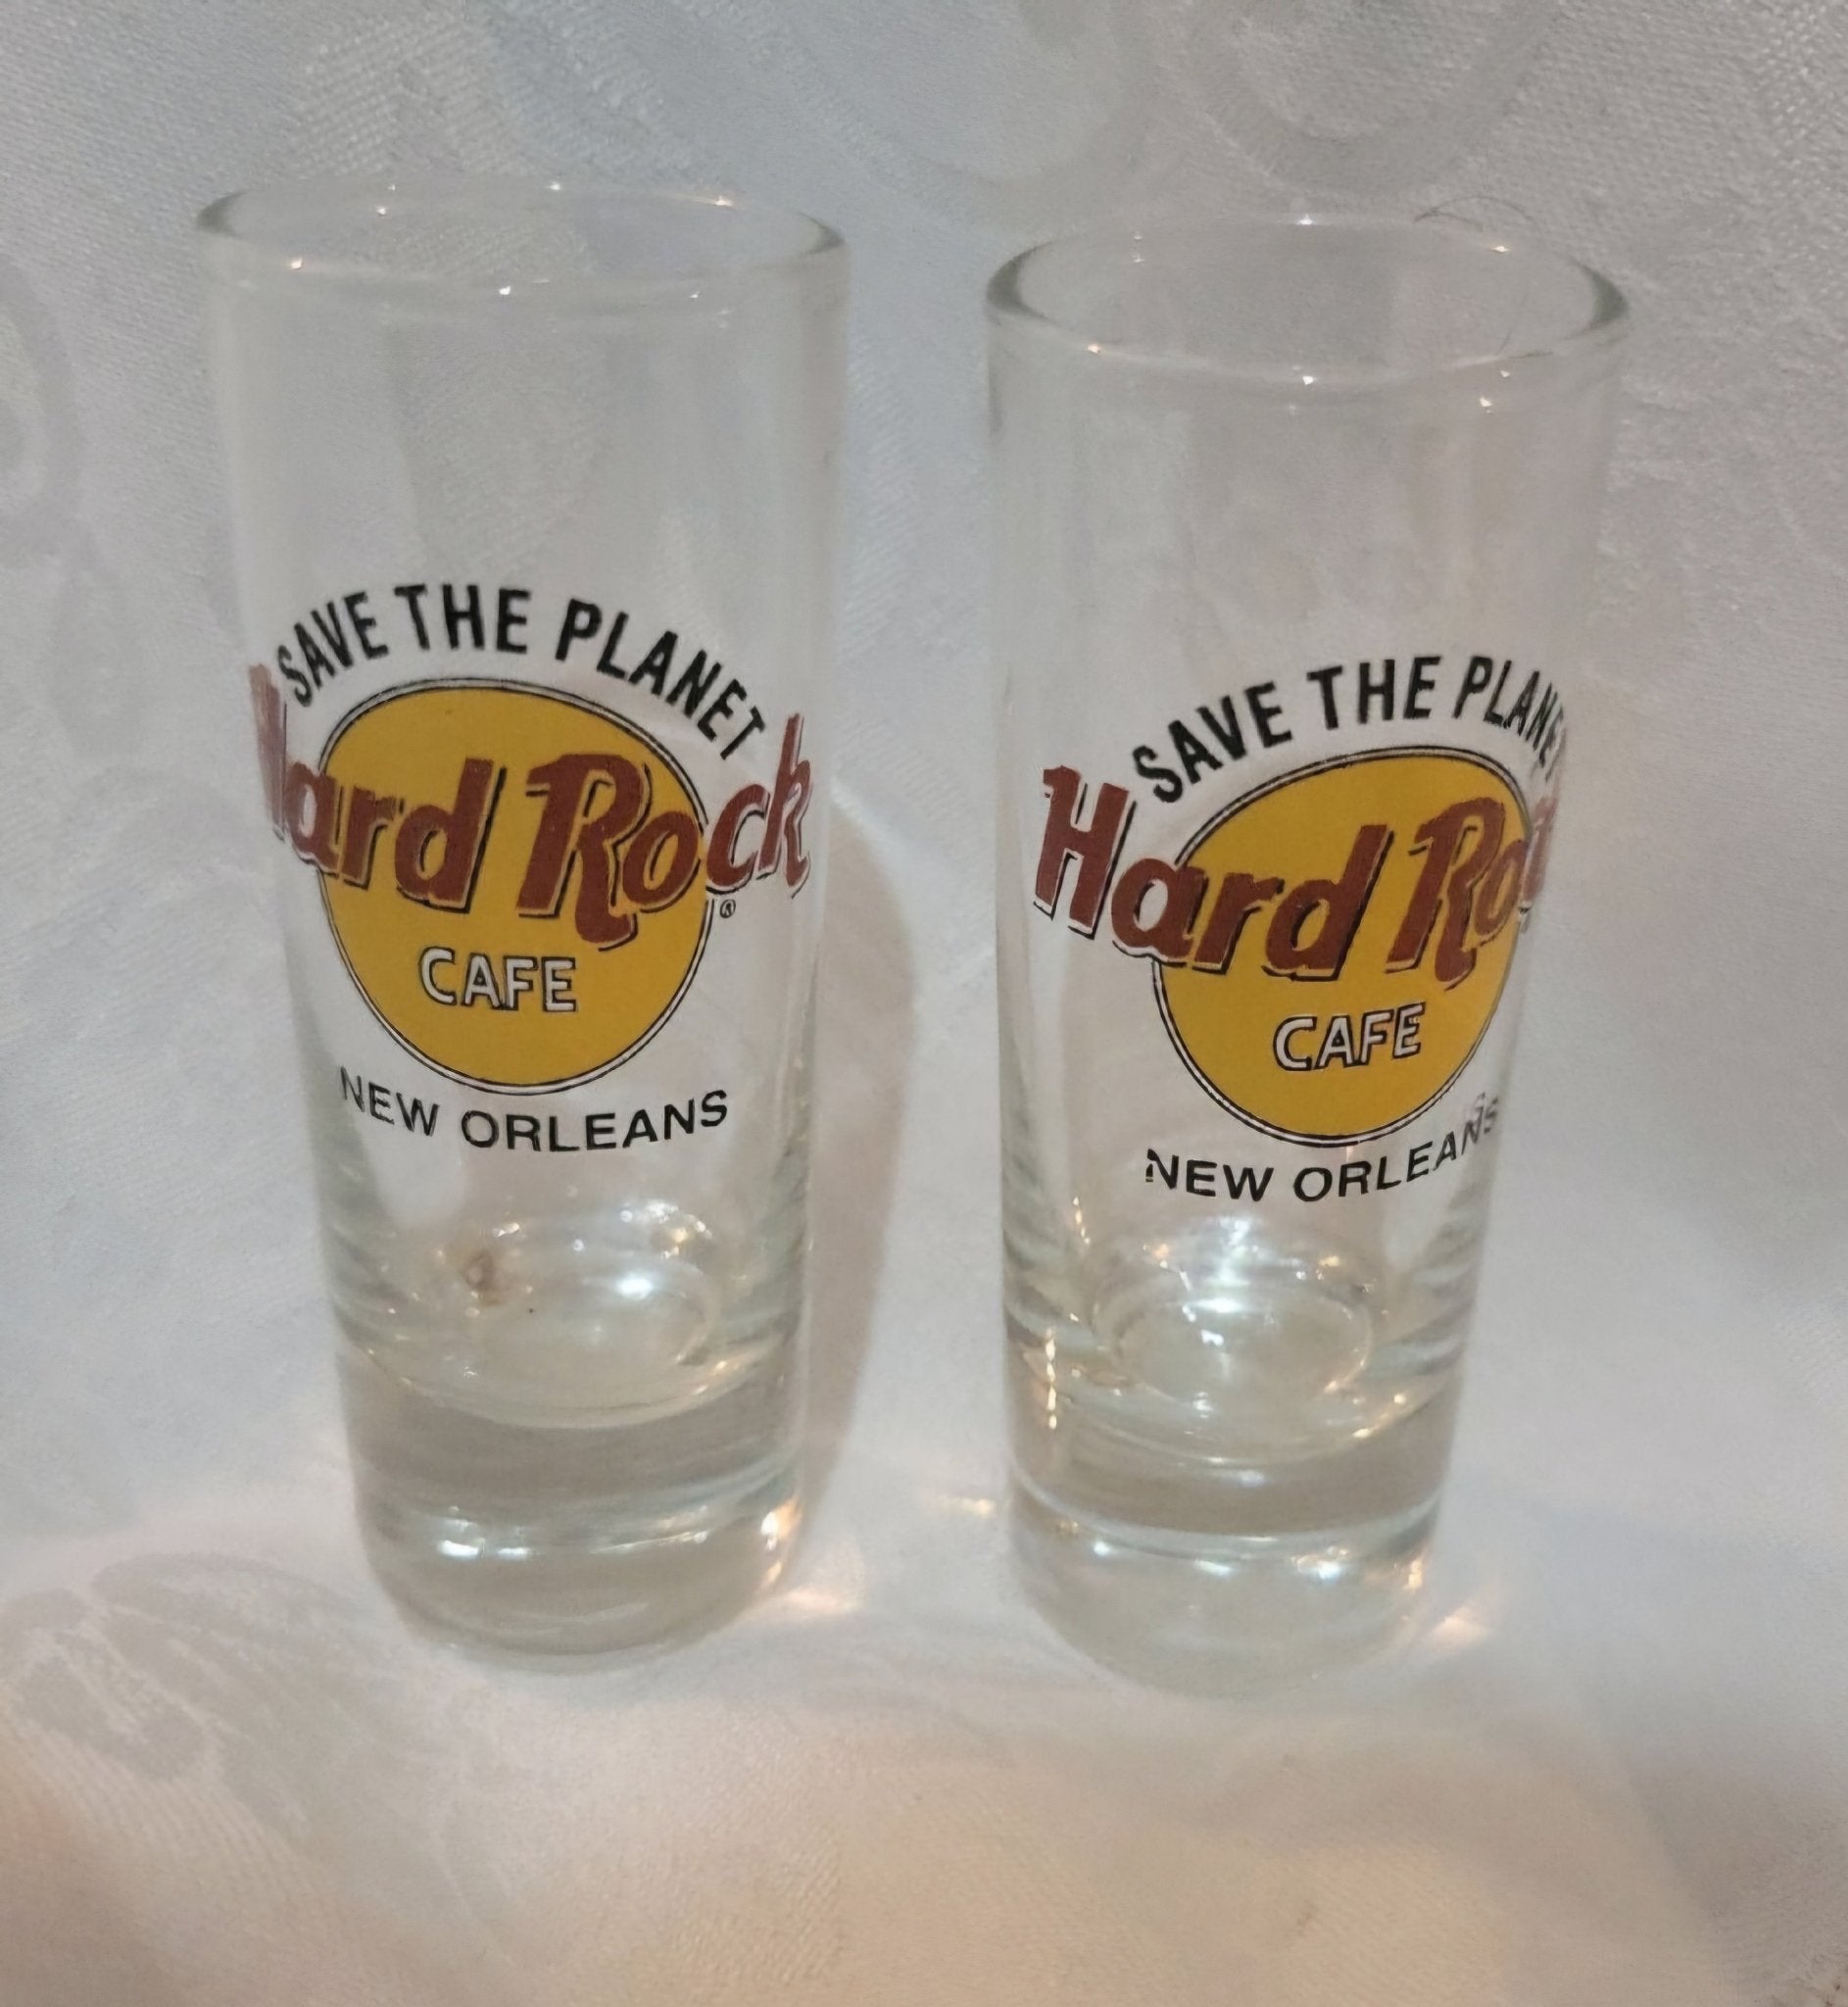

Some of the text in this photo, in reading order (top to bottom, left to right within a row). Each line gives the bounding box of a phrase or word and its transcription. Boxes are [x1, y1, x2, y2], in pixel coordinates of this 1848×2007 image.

[276, 582, 766, 761] SAVE THE PLANET
[1132, 680, 1293, 804] SAVE
[1306, 656, 1442, 730] THE
[514, 712, 813, 953] Rock
[1033, 764, 1394, 983] Hard
[417, 946, 578, 1013] CAFE
[1272, 1001, 1428, 1072] CAFE
[337, 1065, 730, 1153] NEW ORLEANS
[1144, 1095, 1500, 1203] NEW ORLEANS
